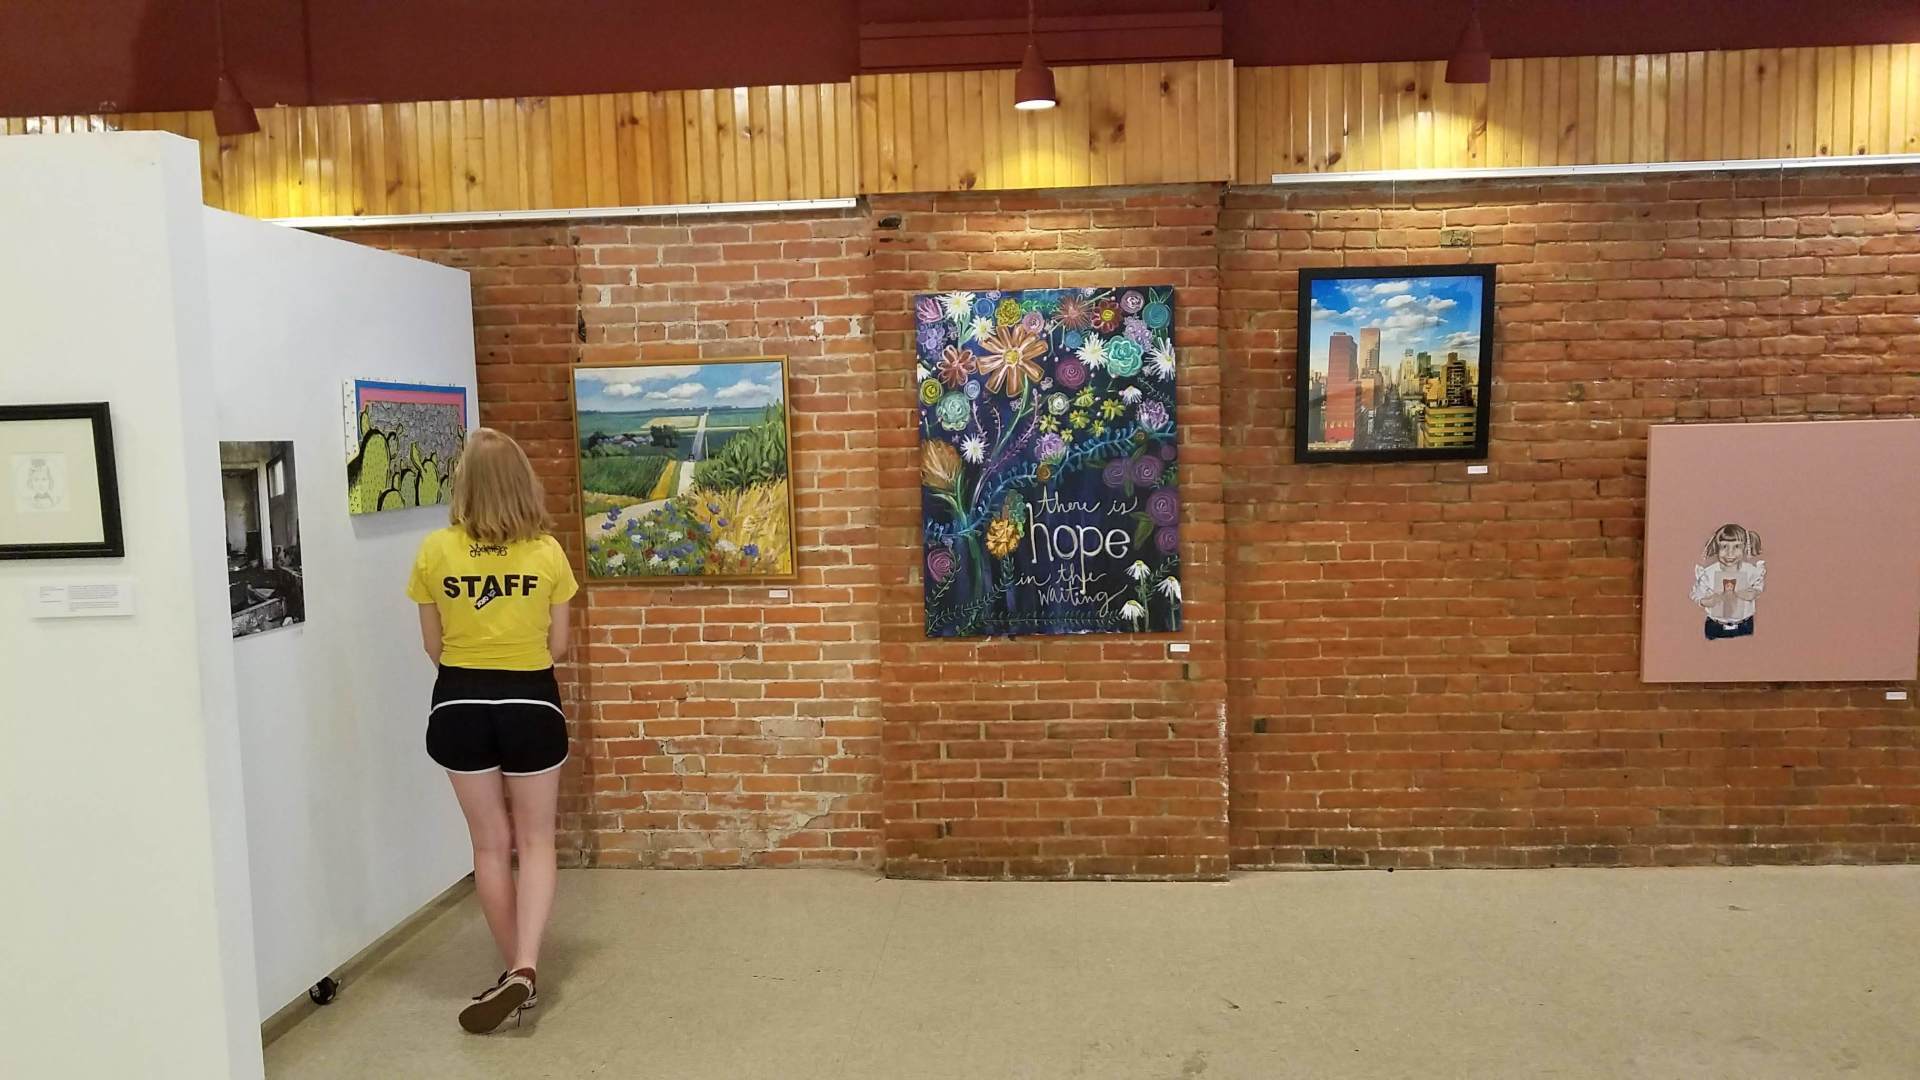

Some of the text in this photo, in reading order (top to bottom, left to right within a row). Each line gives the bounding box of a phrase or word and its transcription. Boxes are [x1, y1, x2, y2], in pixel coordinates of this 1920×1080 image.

[1036, 486, 1138, 517] there is
[1026, 503, 1130, 594] hope
[443, 574, 539, 598] STAFF
[1015, 563, 1107, 586] in the
[1038, 583, 1128, 618] waiting
